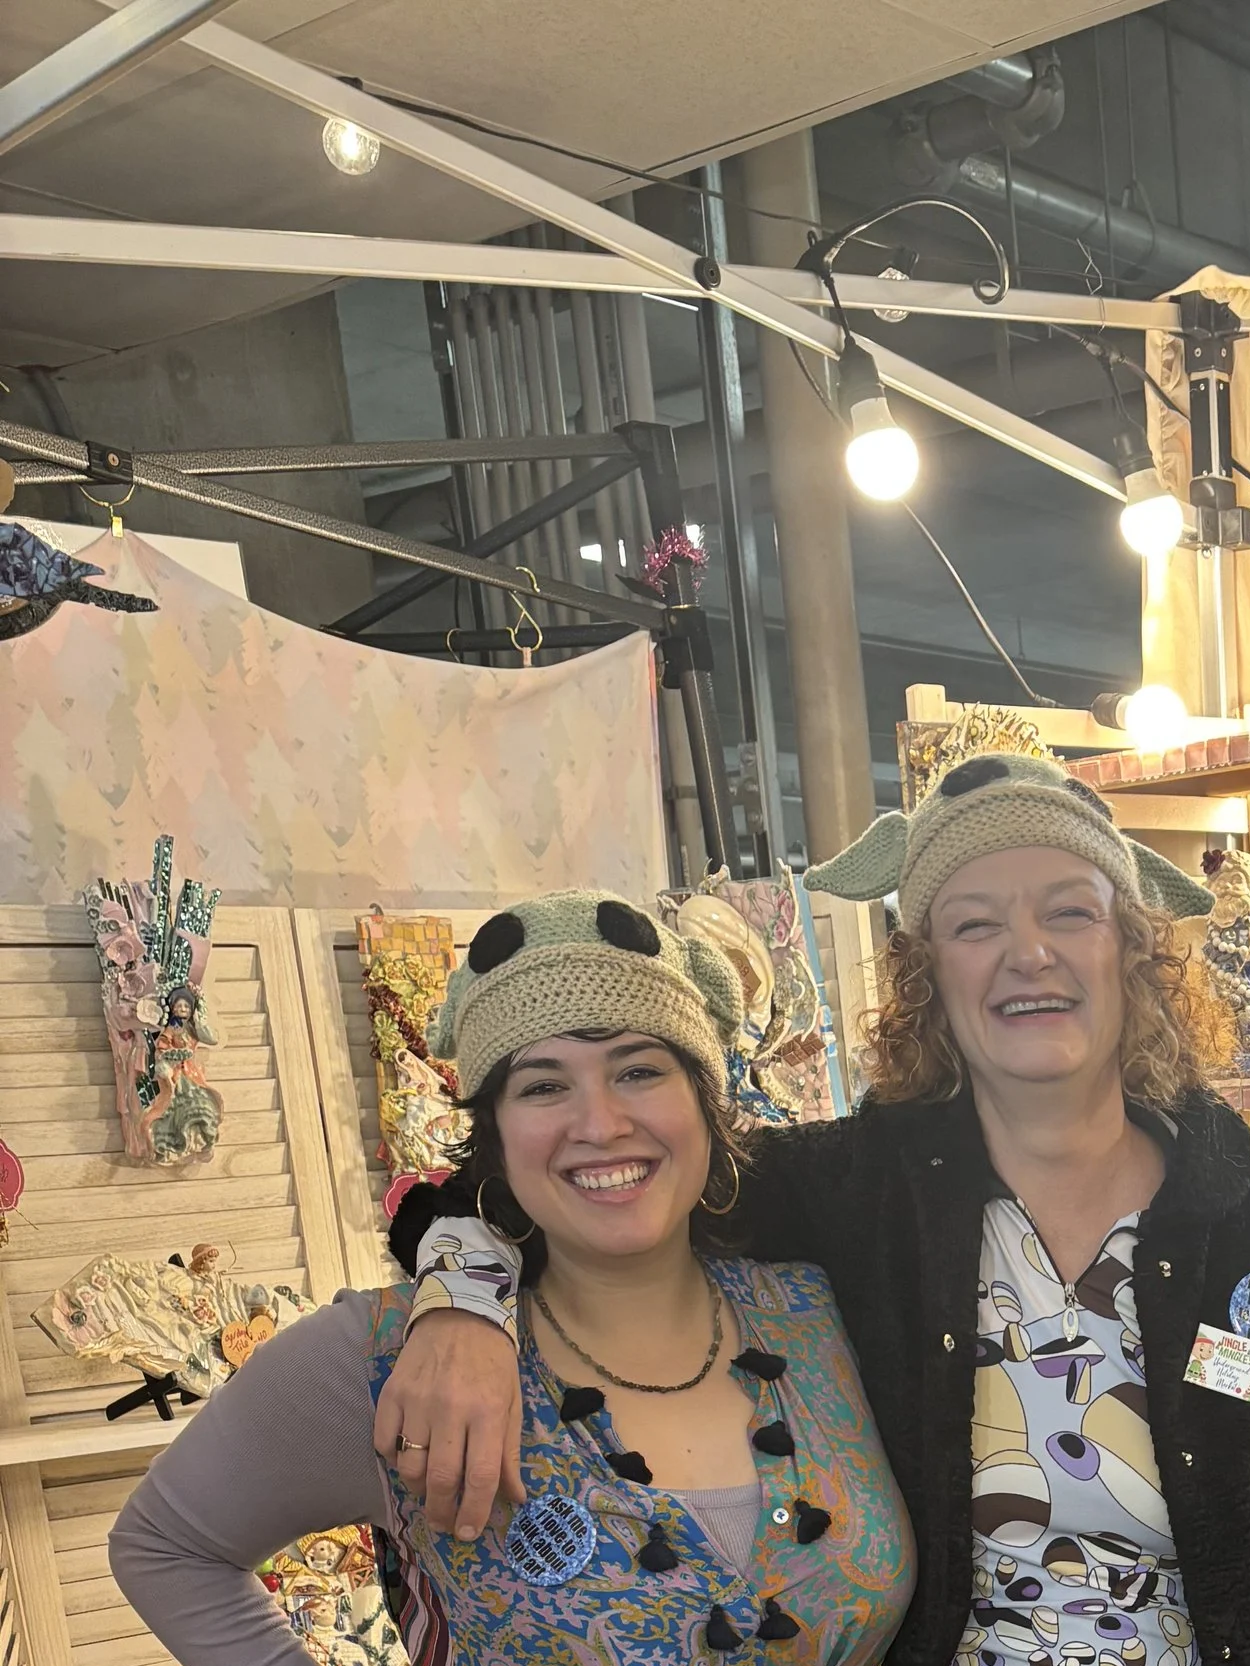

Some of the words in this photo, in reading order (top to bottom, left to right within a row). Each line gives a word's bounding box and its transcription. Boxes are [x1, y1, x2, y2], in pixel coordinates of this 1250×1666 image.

[535, 1509, 548, 1520] I
[547, 1497, 574, 1519] Ask
[540, 1514, 567, 1543] love
[519, 1516, 539, 1542] talk
[533, 1539, 567, 1572] about
[562, 1539, 576, 1556] to
[511, 1539, 530, 1562] my
[523, 1558, 546, 1578] art
